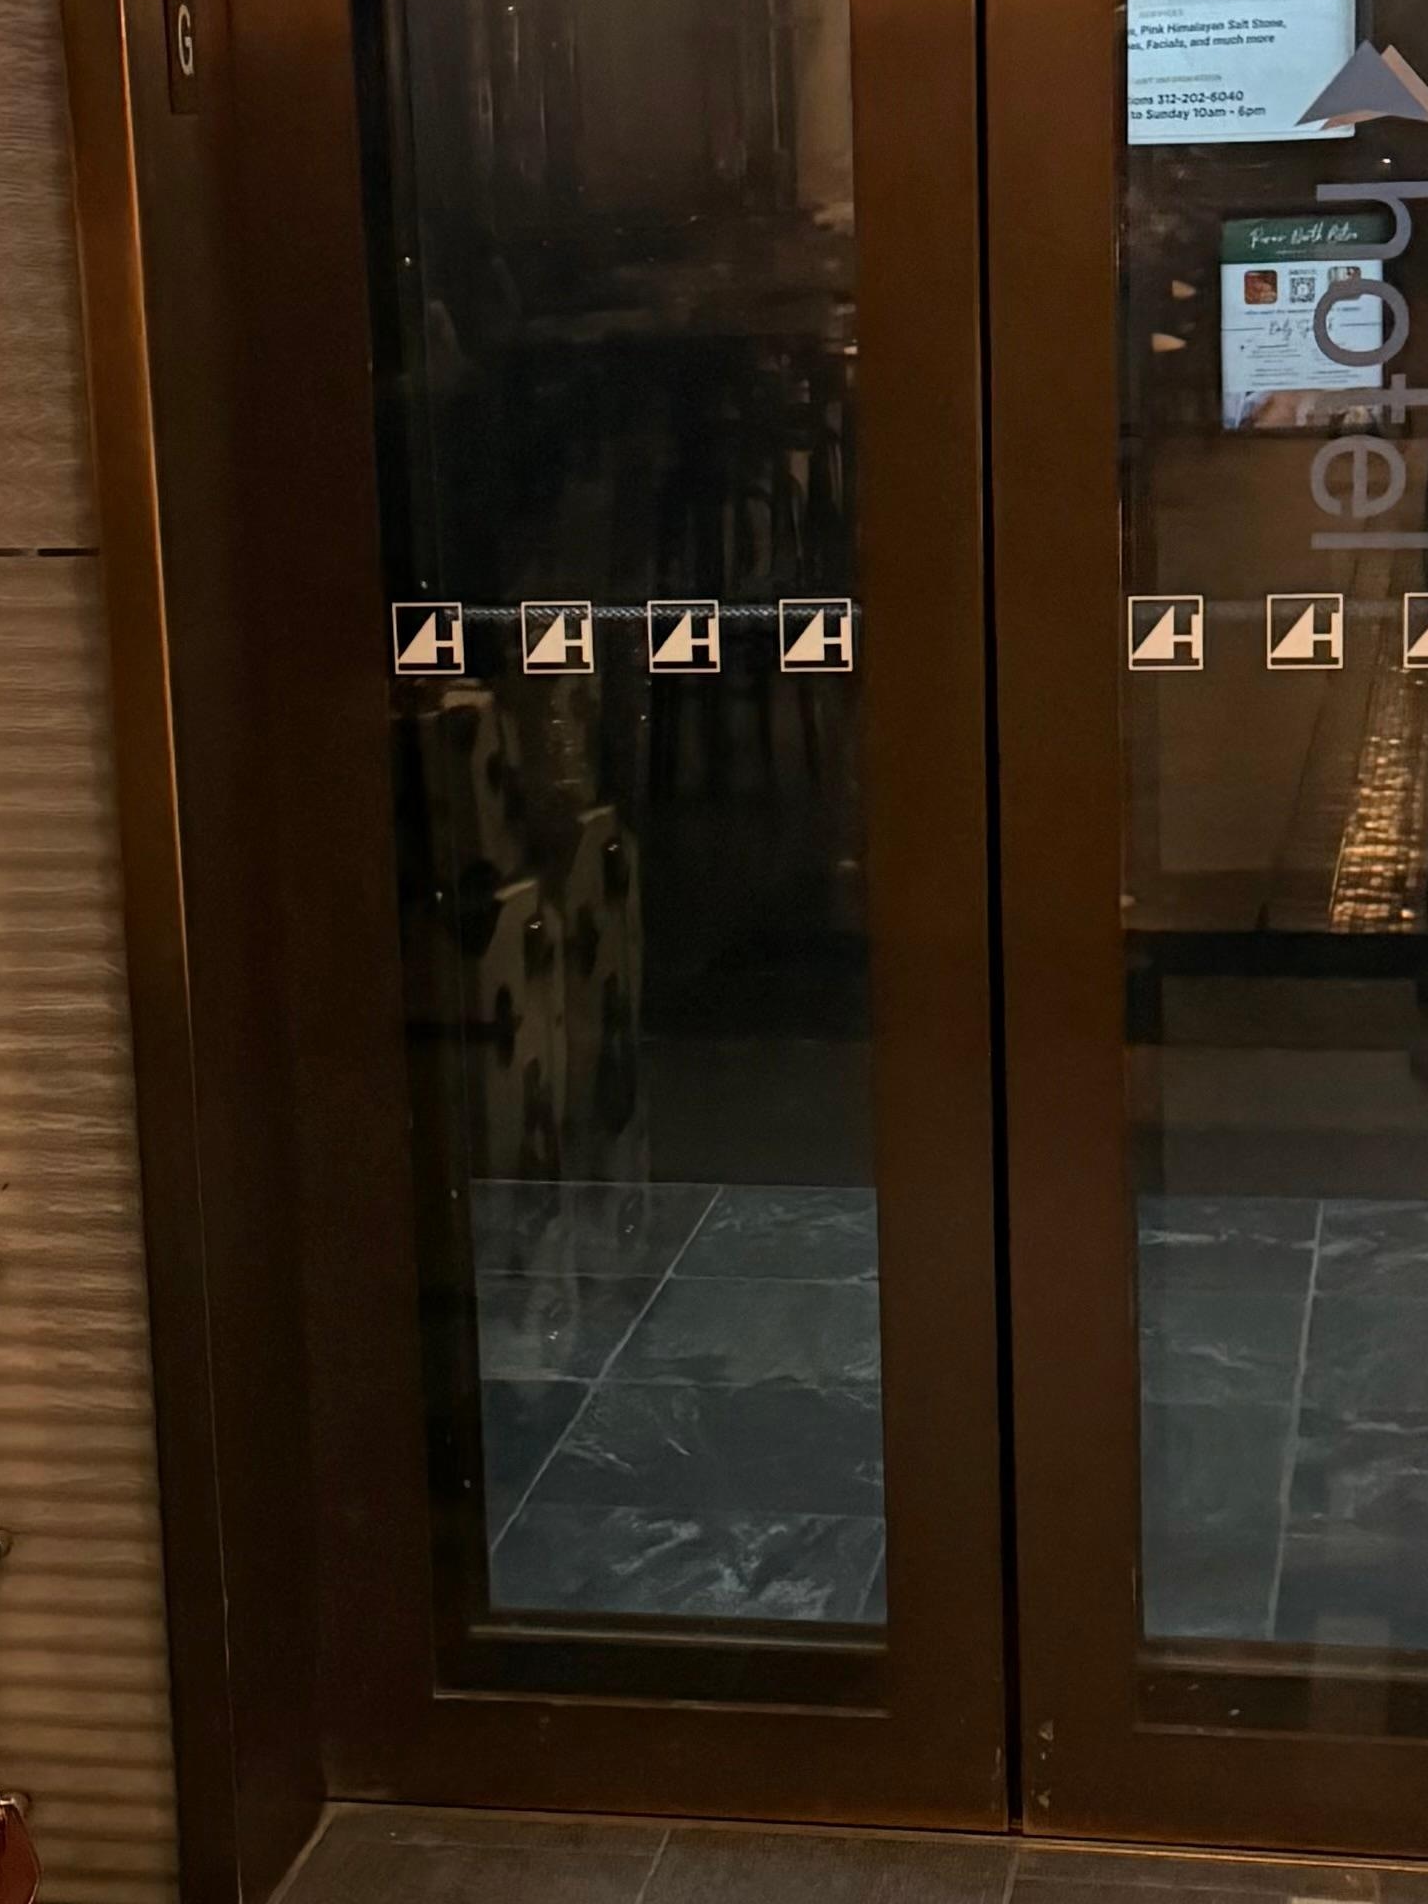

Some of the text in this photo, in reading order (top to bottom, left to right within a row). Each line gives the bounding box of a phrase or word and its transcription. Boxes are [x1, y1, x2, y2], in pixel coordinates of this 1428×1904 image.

[1140, 23, 1164, 36] Pink
[1167, 21, 1225, 35] Himalayan
[1228, 19, 1249, 31] Salt
[178, 4, 194, 76] G
[1146, 38, 1188, 51] Facials,
[1190, 36, 1211, 48] and
[1213, 34, 1244, 46] much
[1246, 33, 1276, 44] more
[1145, 107, 1191, 122] Sunday
[1193, 106, 1227, 119] 10am
[1237, 104, 1267, 118] 6pm
